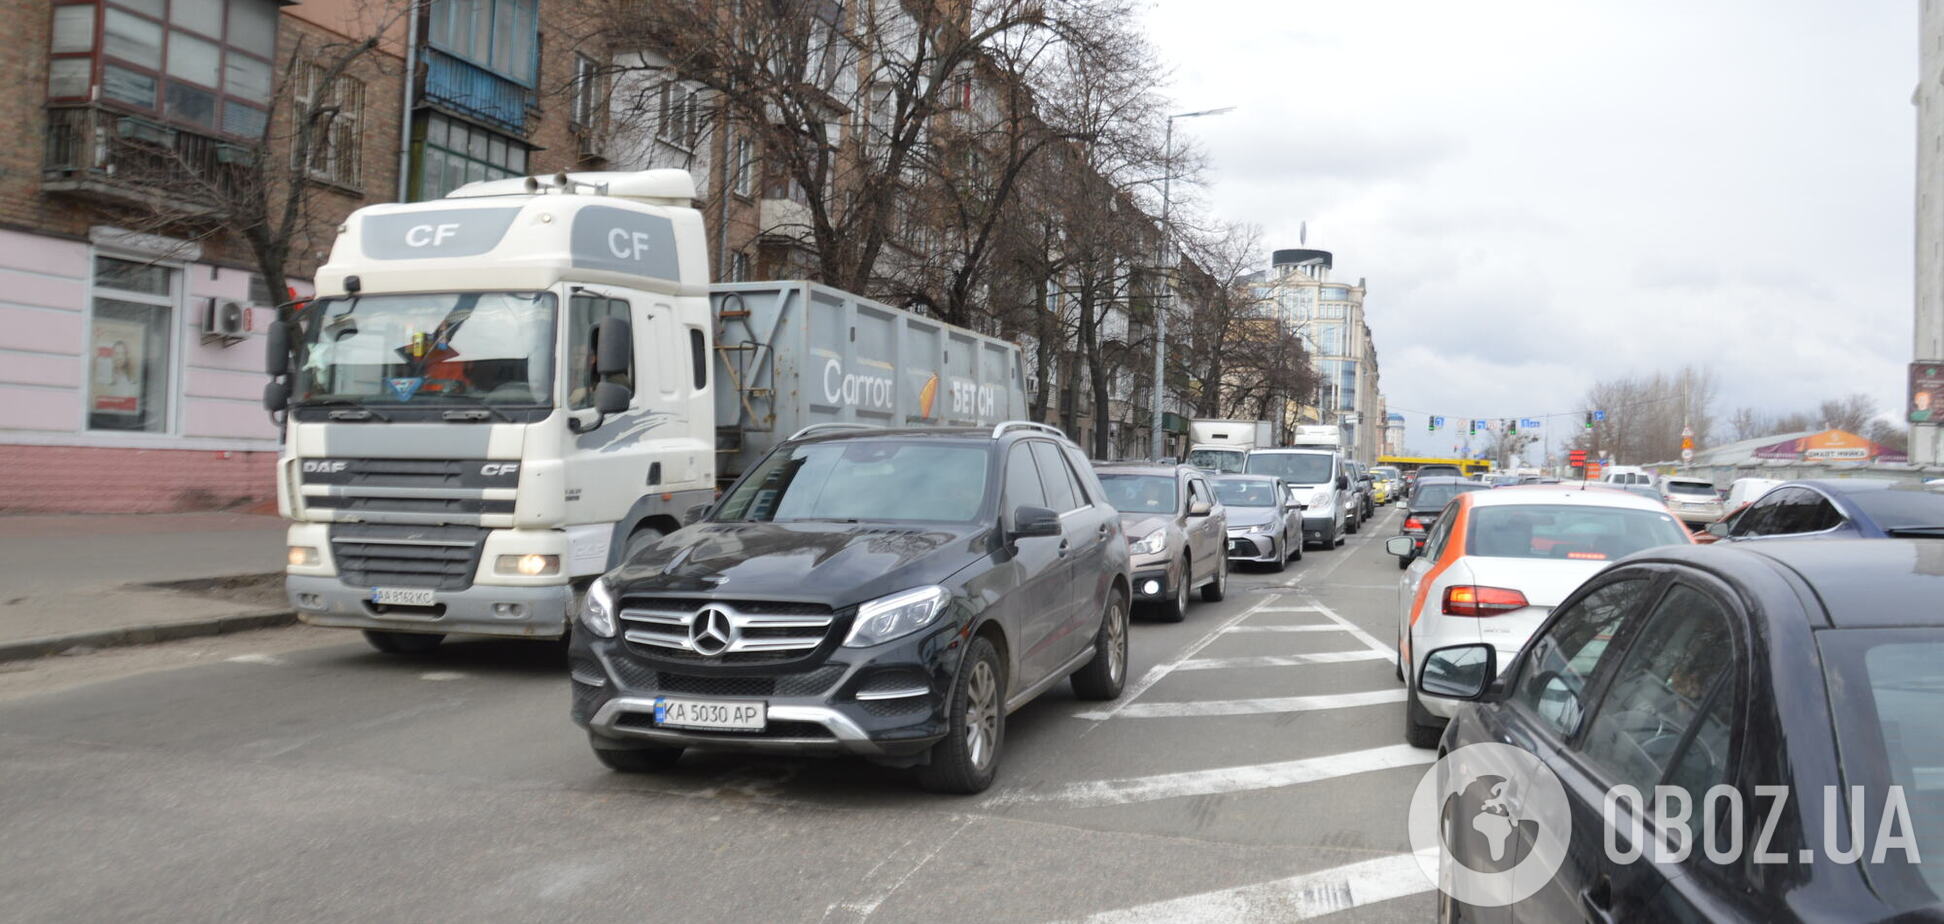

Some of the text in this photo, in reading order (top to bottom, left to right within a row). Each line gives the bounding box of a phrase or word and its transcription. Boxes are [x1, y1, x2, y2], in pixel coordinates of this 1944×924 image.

[405, 223, 460, 248] CF
[607, 227, 649, 261] CF
[823, 358, 894, 409] Carrot
[302, 461, 348, 474] DAF
[480, 463, 518, 476] CF
[664, 703, 757, 724] KA 5030 AP
